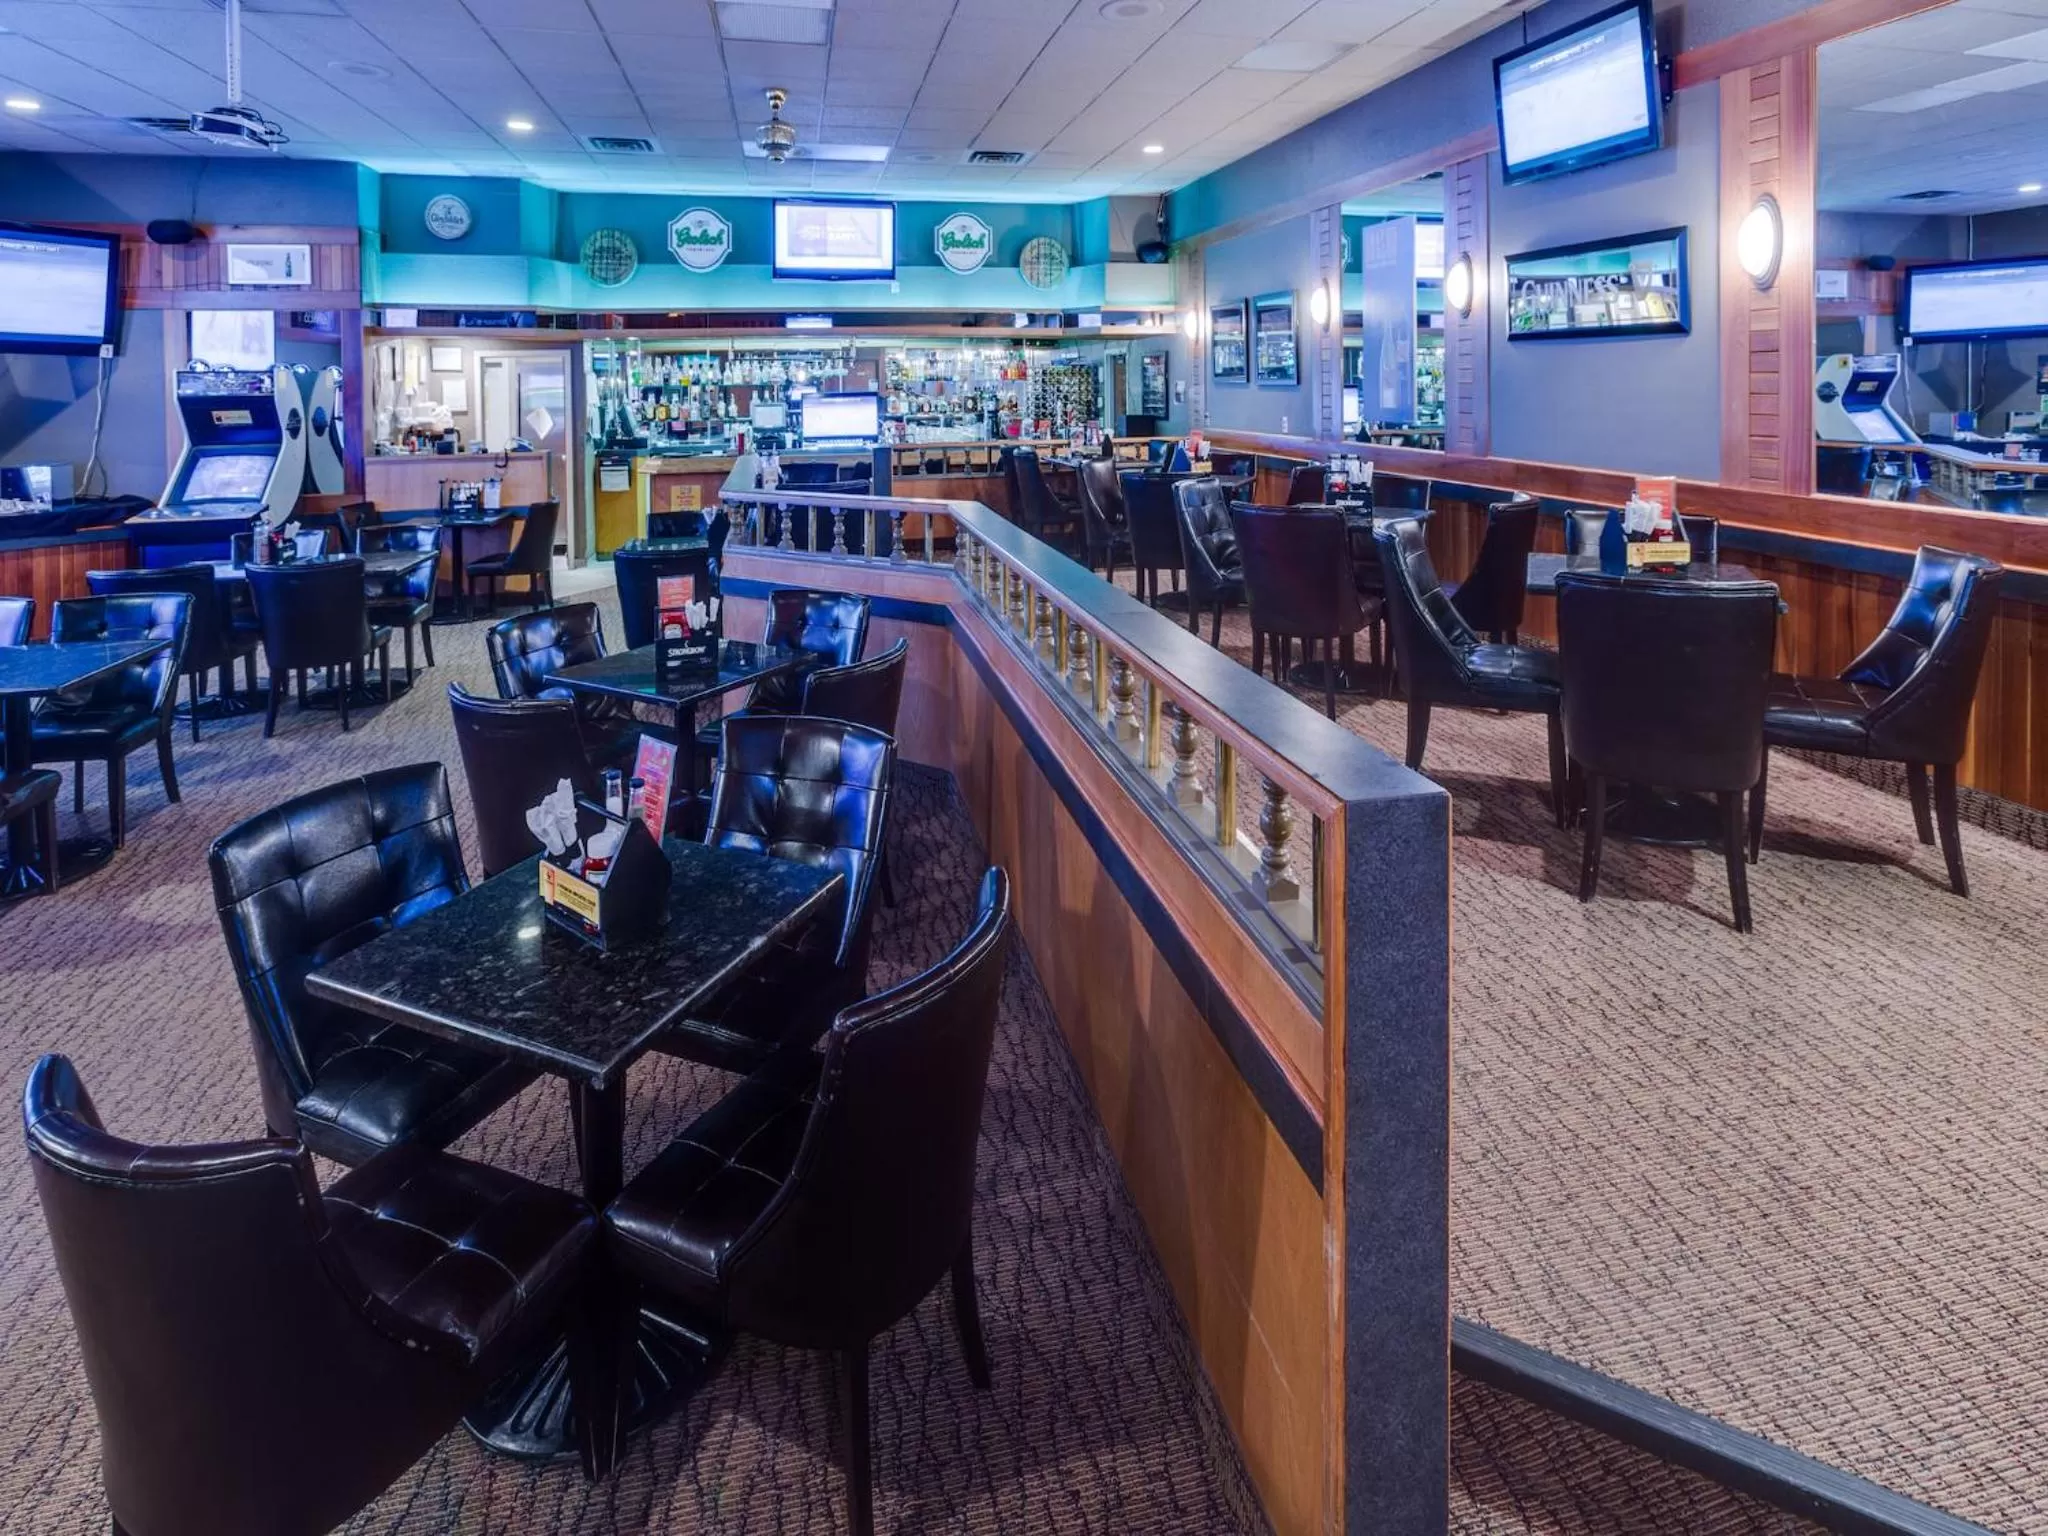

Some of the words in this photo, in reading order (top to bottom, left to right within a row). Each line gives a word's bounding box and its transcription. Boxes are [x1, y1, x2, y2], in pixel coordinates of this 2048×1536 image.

[675, 226, 725, 248] Grolsch
[941, 231, 986, 251] Grolsch
[1520, 274, 1620, 307] GUINNESS
